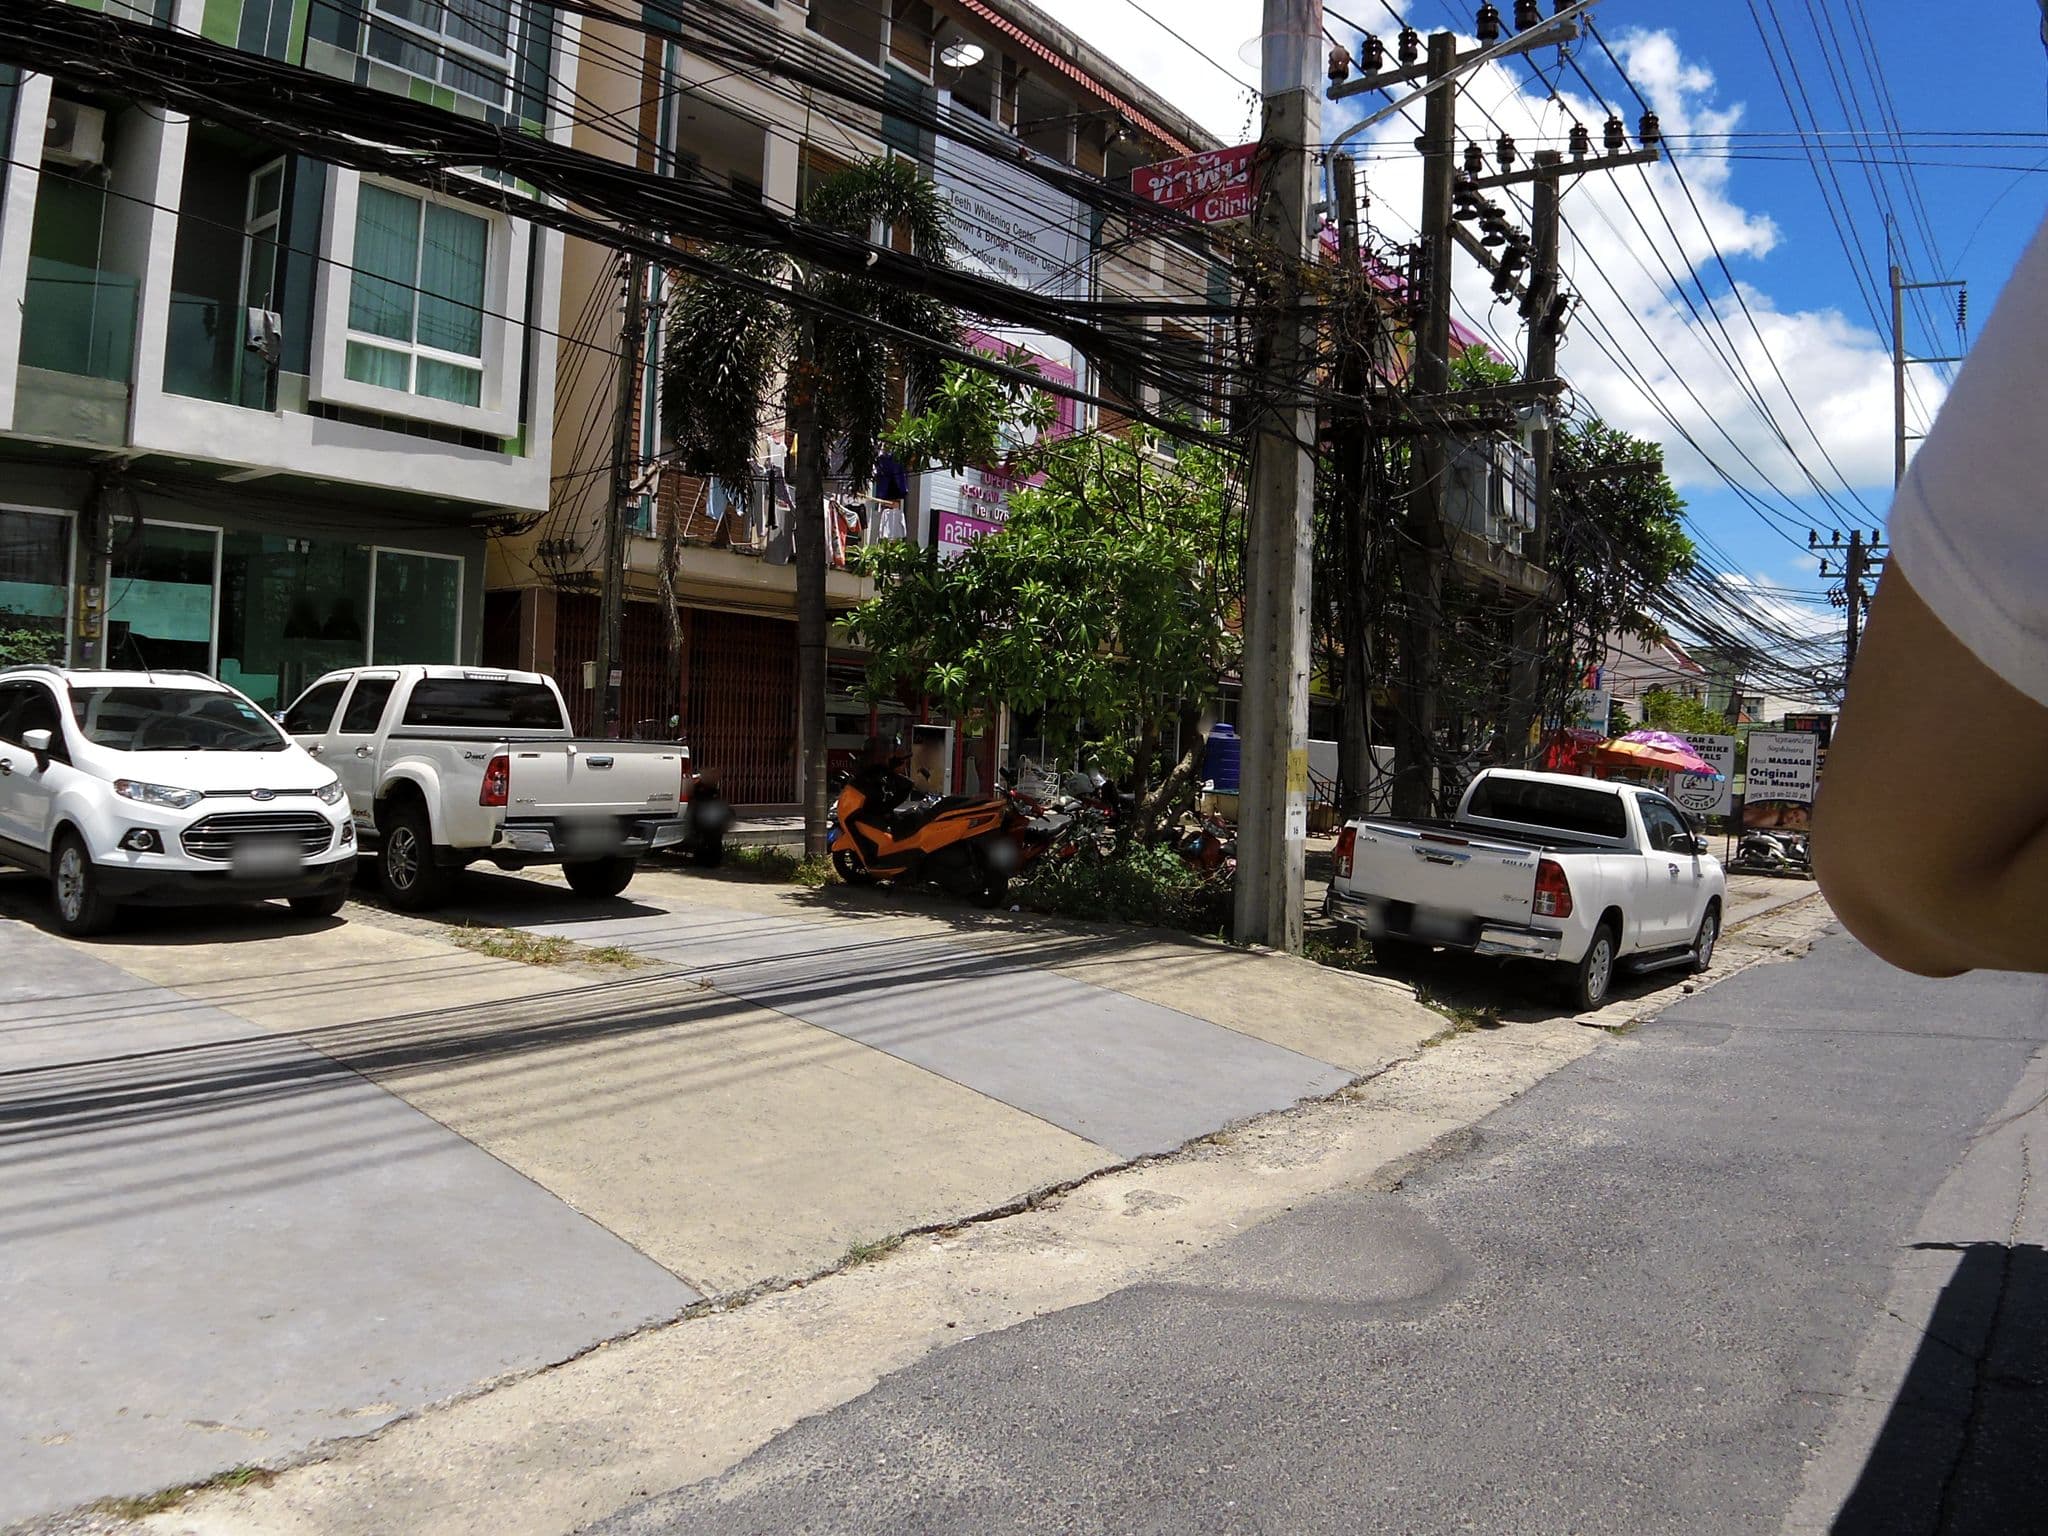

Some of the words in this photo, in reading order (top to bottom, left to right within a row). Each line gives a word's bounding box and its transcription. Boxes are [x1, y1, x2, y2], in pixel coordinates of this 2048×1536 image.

[1148, 154, 1249, 201] ทำฟัน
[949, 189, 972, 212] Teeth
[974, 202, 1012, 235] Whitening
[1012, 222, 1037, 244] Center
[976, 226, 982, 239] &
[972, 247, 997, 266] colour
[998, 258, 1018, 279] filling
[1686, 736, 1706, 744] CAR
[1693, 744, 1729, 753] ORBIKE
[1699, 753, 1722, 761] TALS
[1768, 757, 1812, 766] MASSAGE
[1750, 768, 1798, 779] Original
[1748, 778, 1768, 786] Thai
[1770, 779, 1811, 790] Massage
